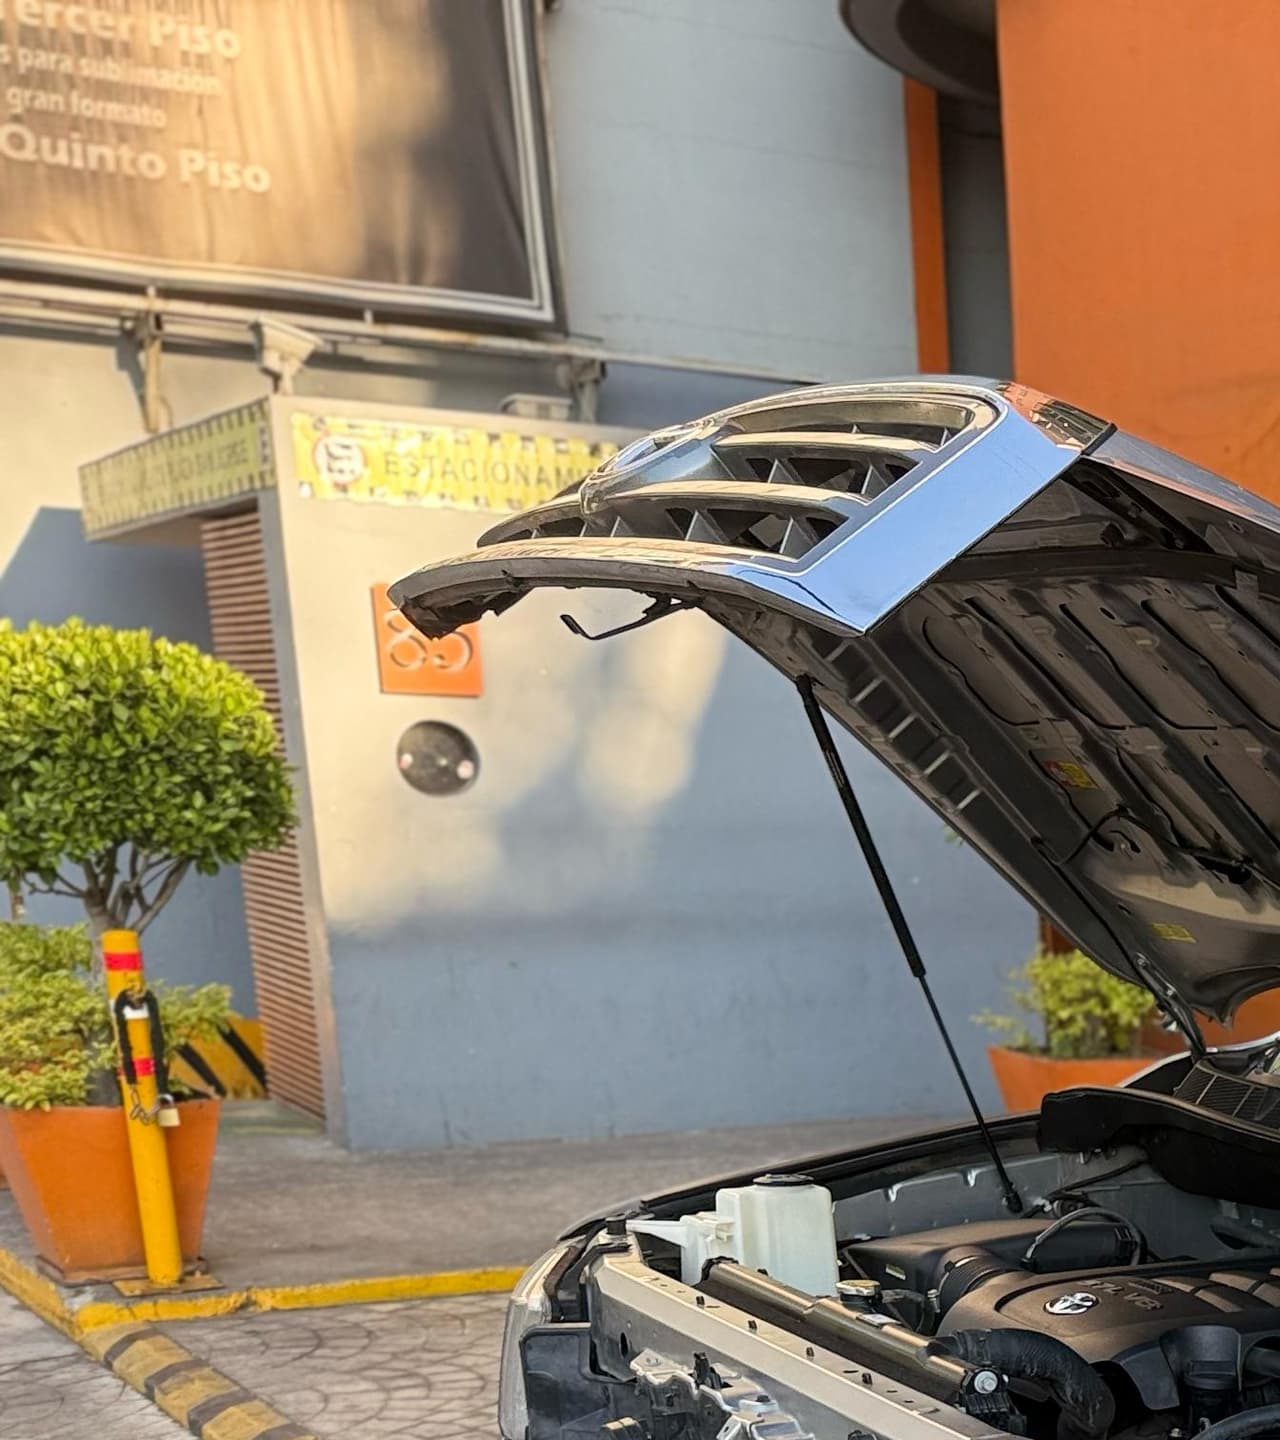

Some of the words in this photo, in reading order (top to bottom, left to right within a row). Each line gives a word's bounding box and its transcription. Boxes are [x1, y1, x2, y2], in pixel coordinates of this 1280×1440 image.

[0, 0, 134, 42] ercer
[151, 10, 240, 58] Piso
[17, 46, 73, 74] para
[6, 85, 66, 116] gran
[69, 91, 168, 129] formato
[0, 123, 167, 180] Quinto
[178, 149, 271, 193] Piso
